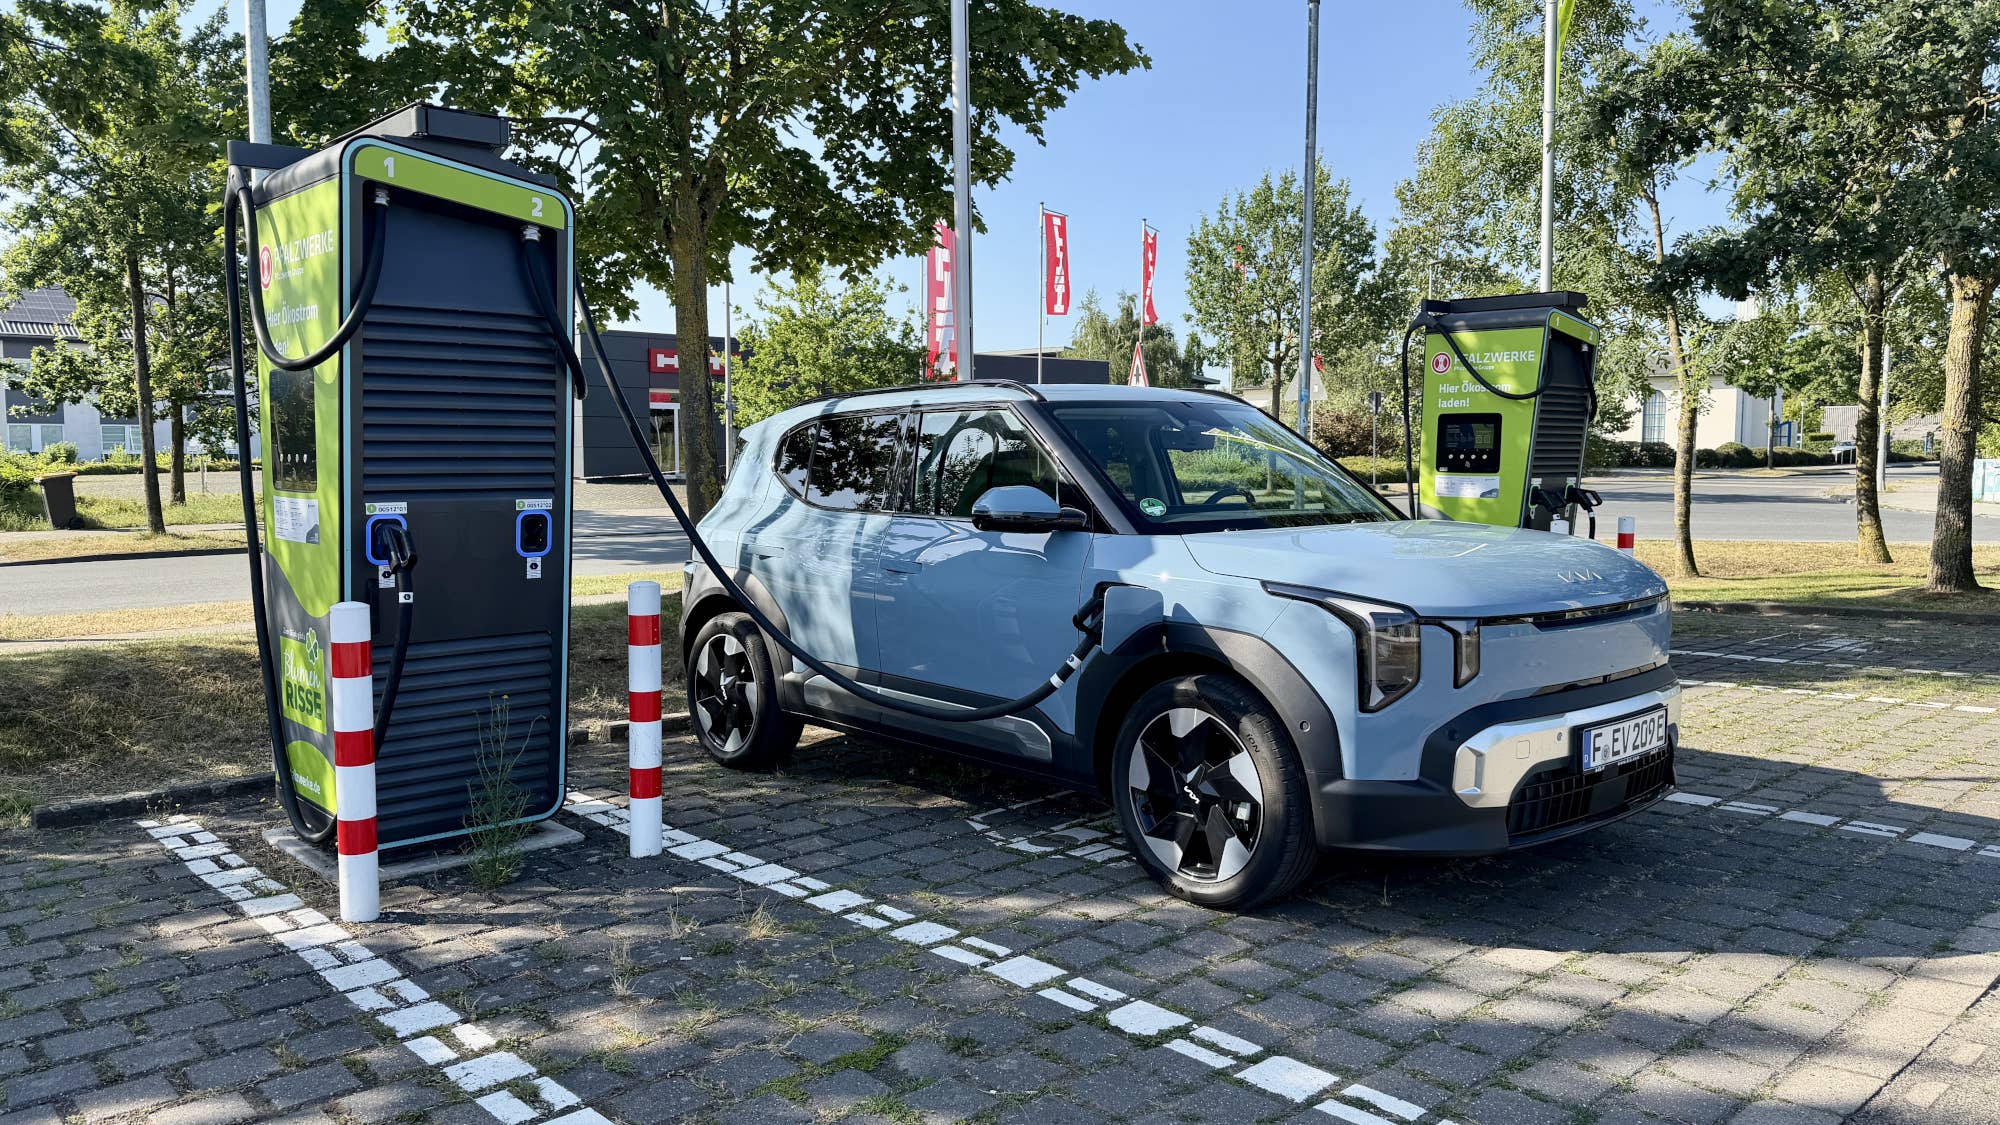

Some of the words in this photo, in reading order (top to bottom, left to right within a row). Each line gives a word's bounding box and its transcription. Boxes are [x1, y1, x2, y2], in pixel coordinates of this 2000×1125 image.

[383, 156, 395, 177] 1
[531, 197, 543, 218] 2
[282, 300, 319, 325] Ökostrom
[1439, 383, 1459, 394] Hier
[1461, 380, 1512, 393] Ökosom
[1438, 397, 1470, 408] laden!
[283, 648, 321, 689] Blumen
[285, 680, 322, 720] RISSE
[1592, 732, 1603, 762] F
